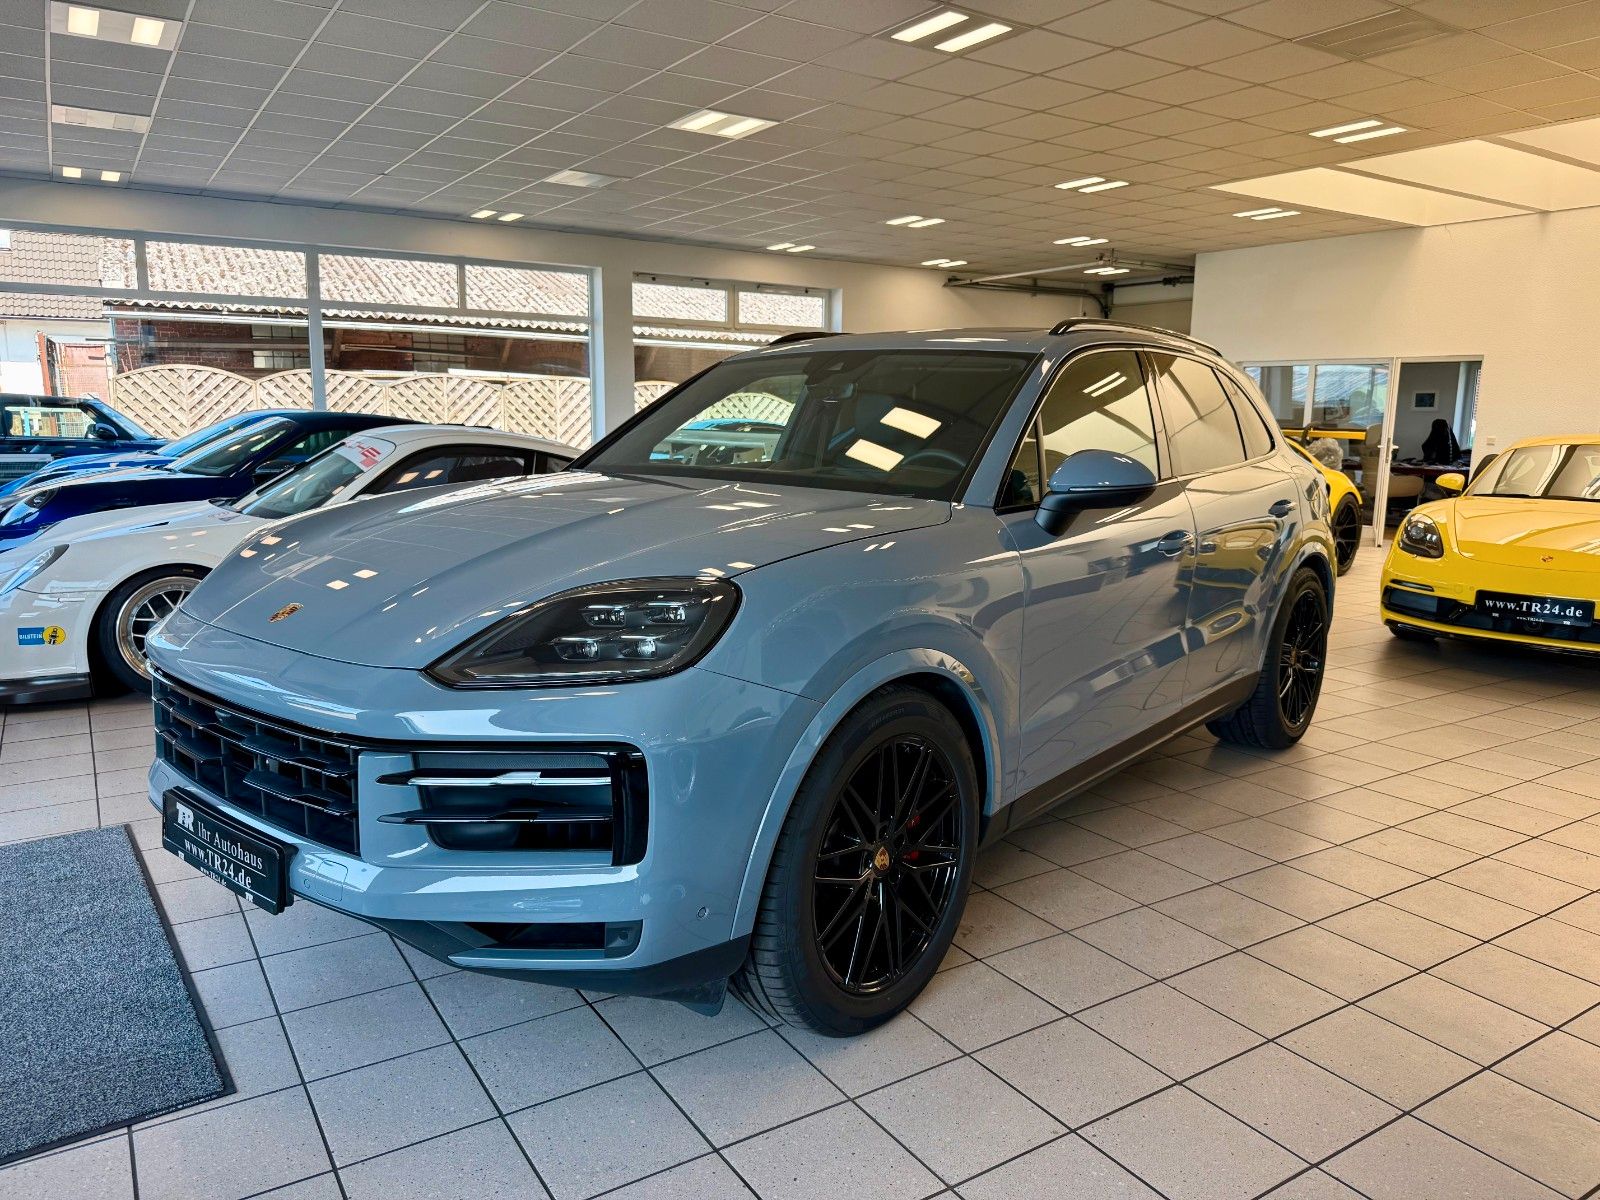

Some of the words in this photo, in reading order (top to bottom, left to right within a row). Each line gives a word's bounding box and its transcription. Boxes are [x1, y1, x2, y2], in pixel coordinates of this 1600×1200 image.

[1485, 599, 1583, 617] www.TR24.de
[184, 840, 252, 889] www.TR24.de
[198, 821, 211, 842] Ihr
[213, 832, 263, 870] Autohaus
